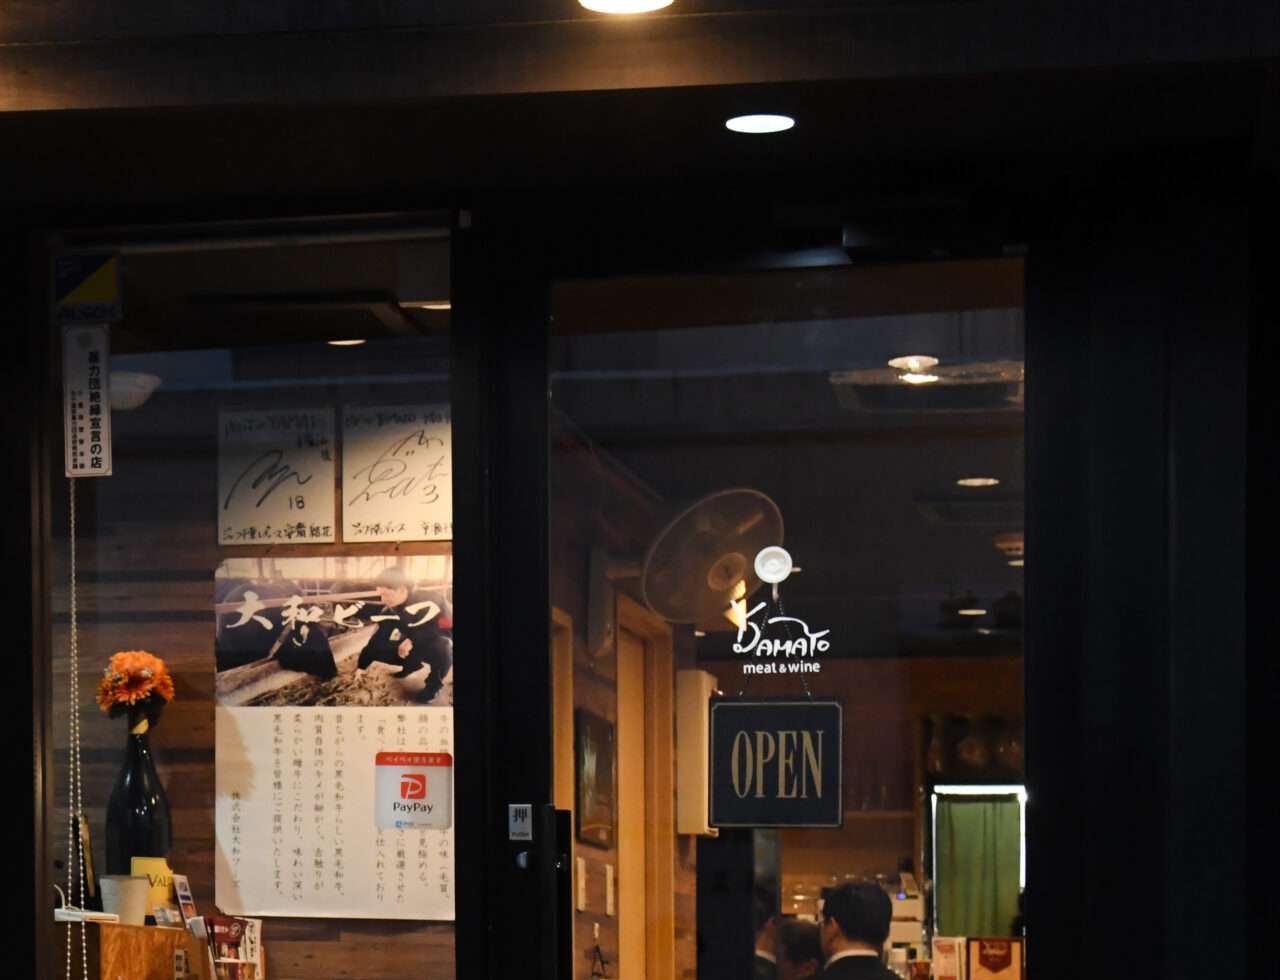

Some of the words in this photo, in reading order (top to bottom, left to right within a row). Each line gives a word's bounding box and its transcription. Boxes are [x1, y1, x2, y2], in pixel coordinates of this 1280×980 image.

[88, 350, 104, 470] 暴力団絶縁宣言の店
[743, 661, 777, 674] meat
[788, 660, 821, 673] wine
[731, 730, 824, 799] OPEN
[392, 802, 434, 814] PayPay
